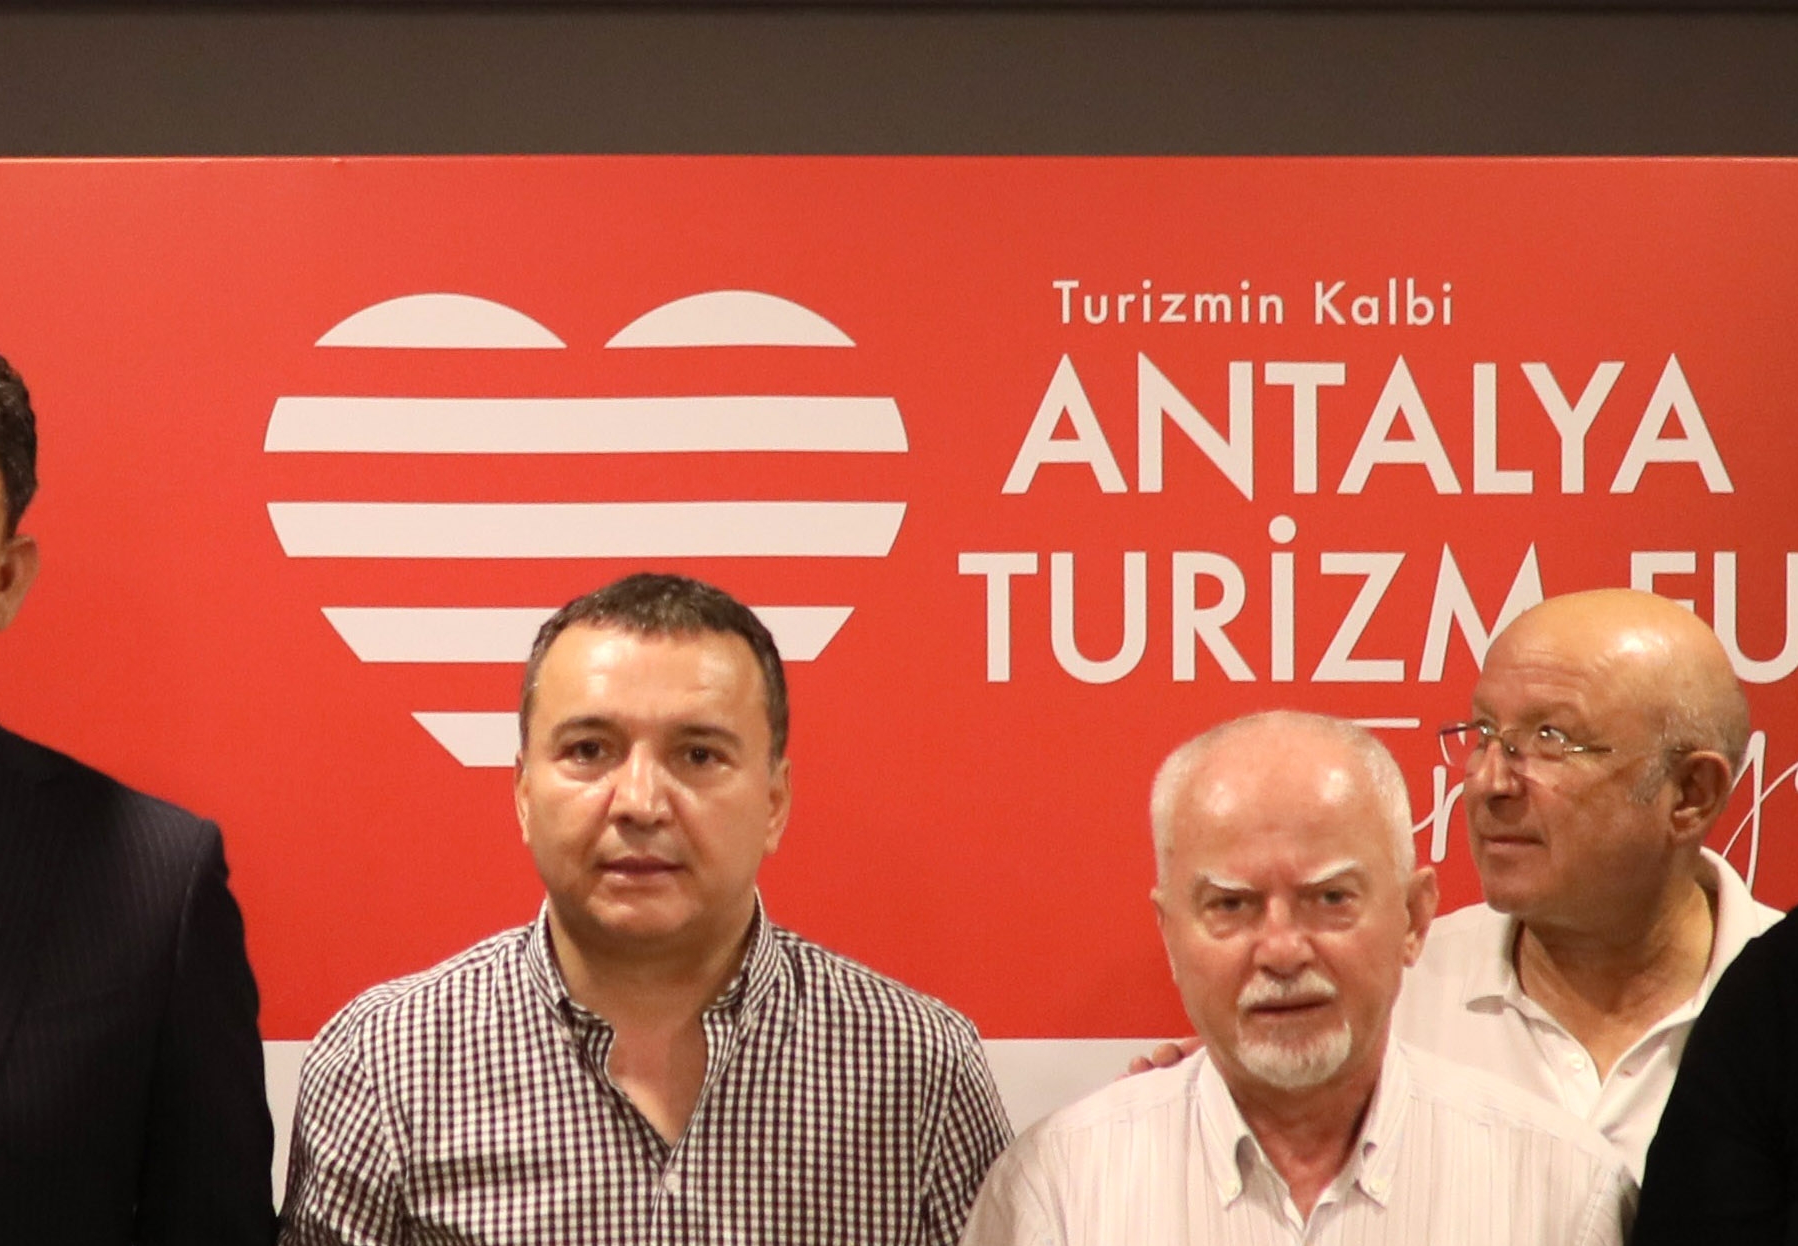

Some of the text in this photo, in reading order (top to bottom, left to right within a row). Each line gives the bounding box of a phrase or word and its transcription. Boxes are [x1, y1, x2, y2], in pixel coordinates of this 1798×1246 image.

[1052, 277, 1453, 326] Turizmin Kalbi
[1000, 351, 1734, 502] ANTALYA
[957, 514, 1545, 684] TURİZM
